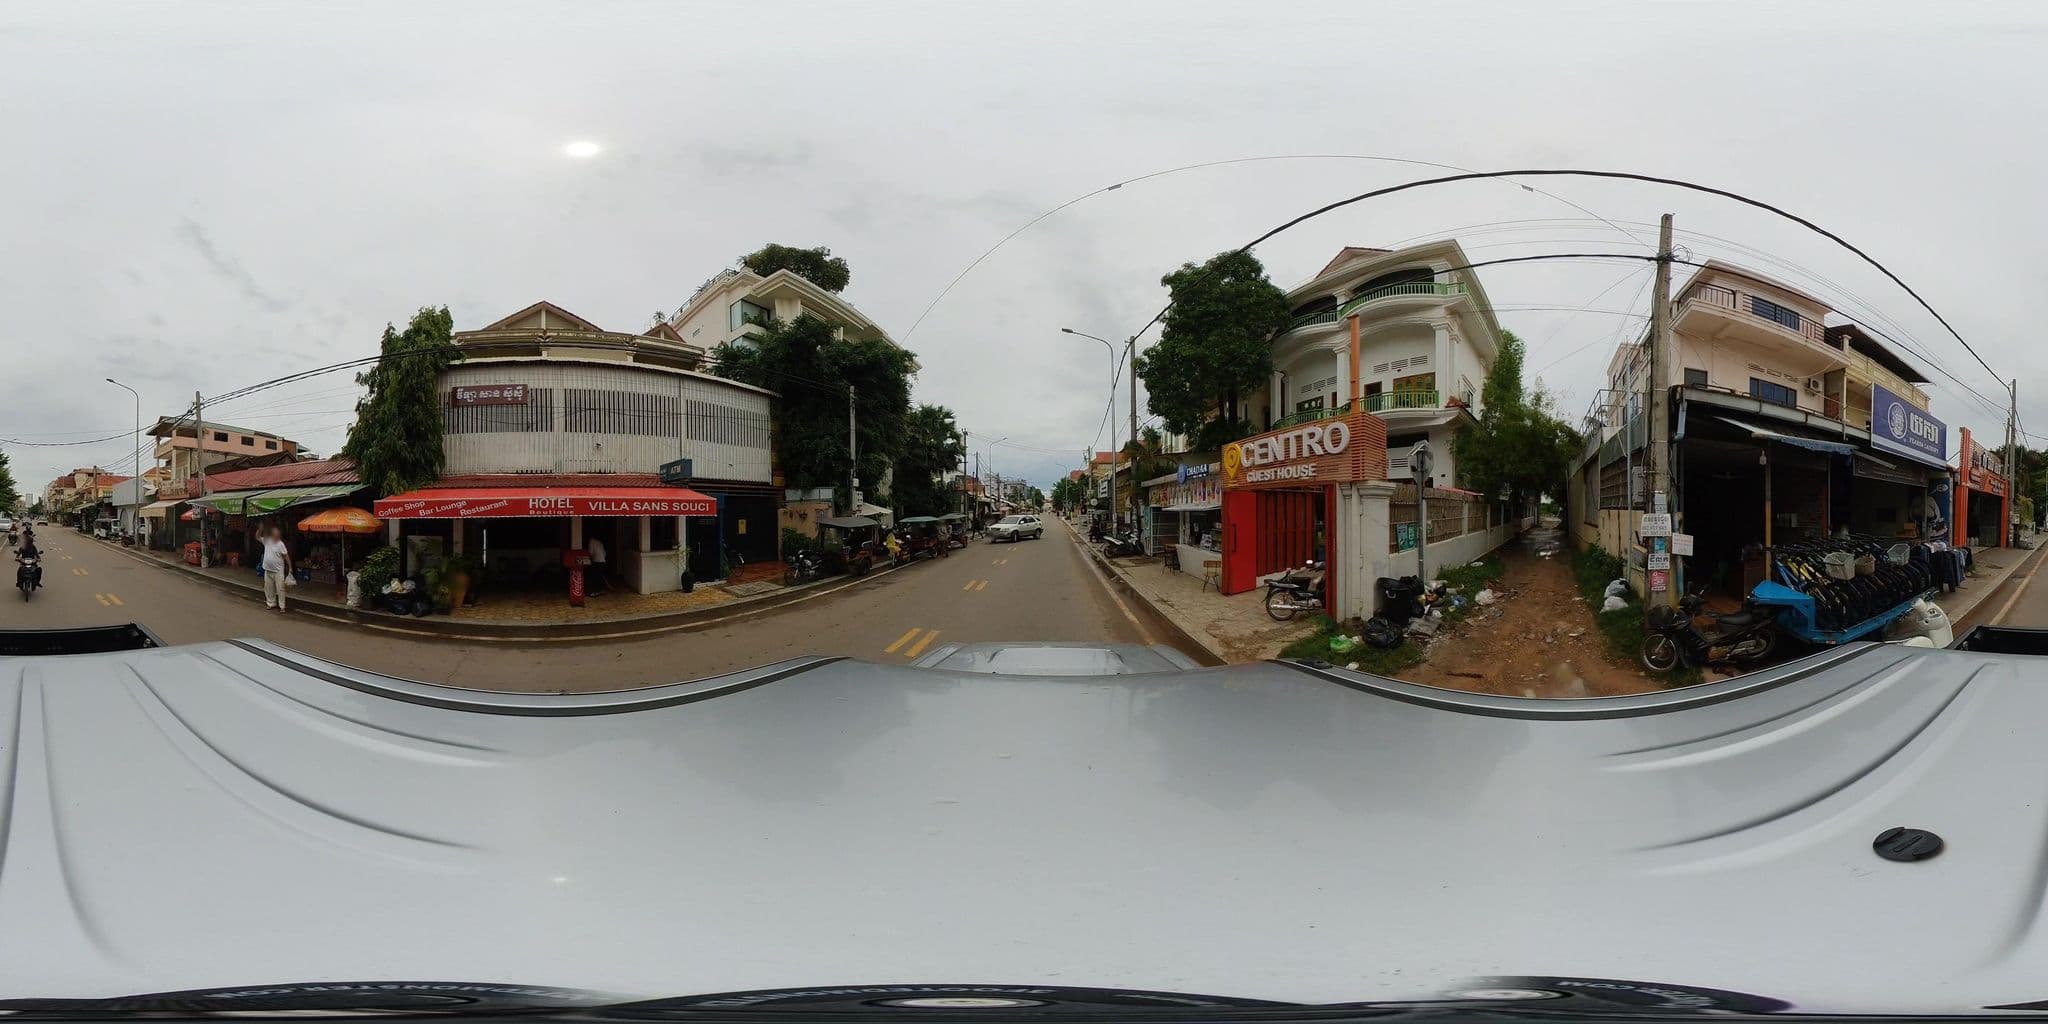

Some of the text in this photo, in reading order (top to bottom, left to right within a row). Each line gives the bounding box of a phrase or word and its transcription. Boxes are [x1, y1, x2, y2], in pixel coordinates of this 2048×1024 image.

[1240, 421, 1351, 468] CENTRO
[1246, 463, 1317, 483] GUESTHOUSE
[378, 500, 426, 517] Coffee Shop
[418, 499, 468, 517] Bar Lounge
[459, 500, 509, 517] Restaurant
[528, 498, 574, 509] HOTEL
[589, 502, 709, 512] VILLA SANS SOUCI
